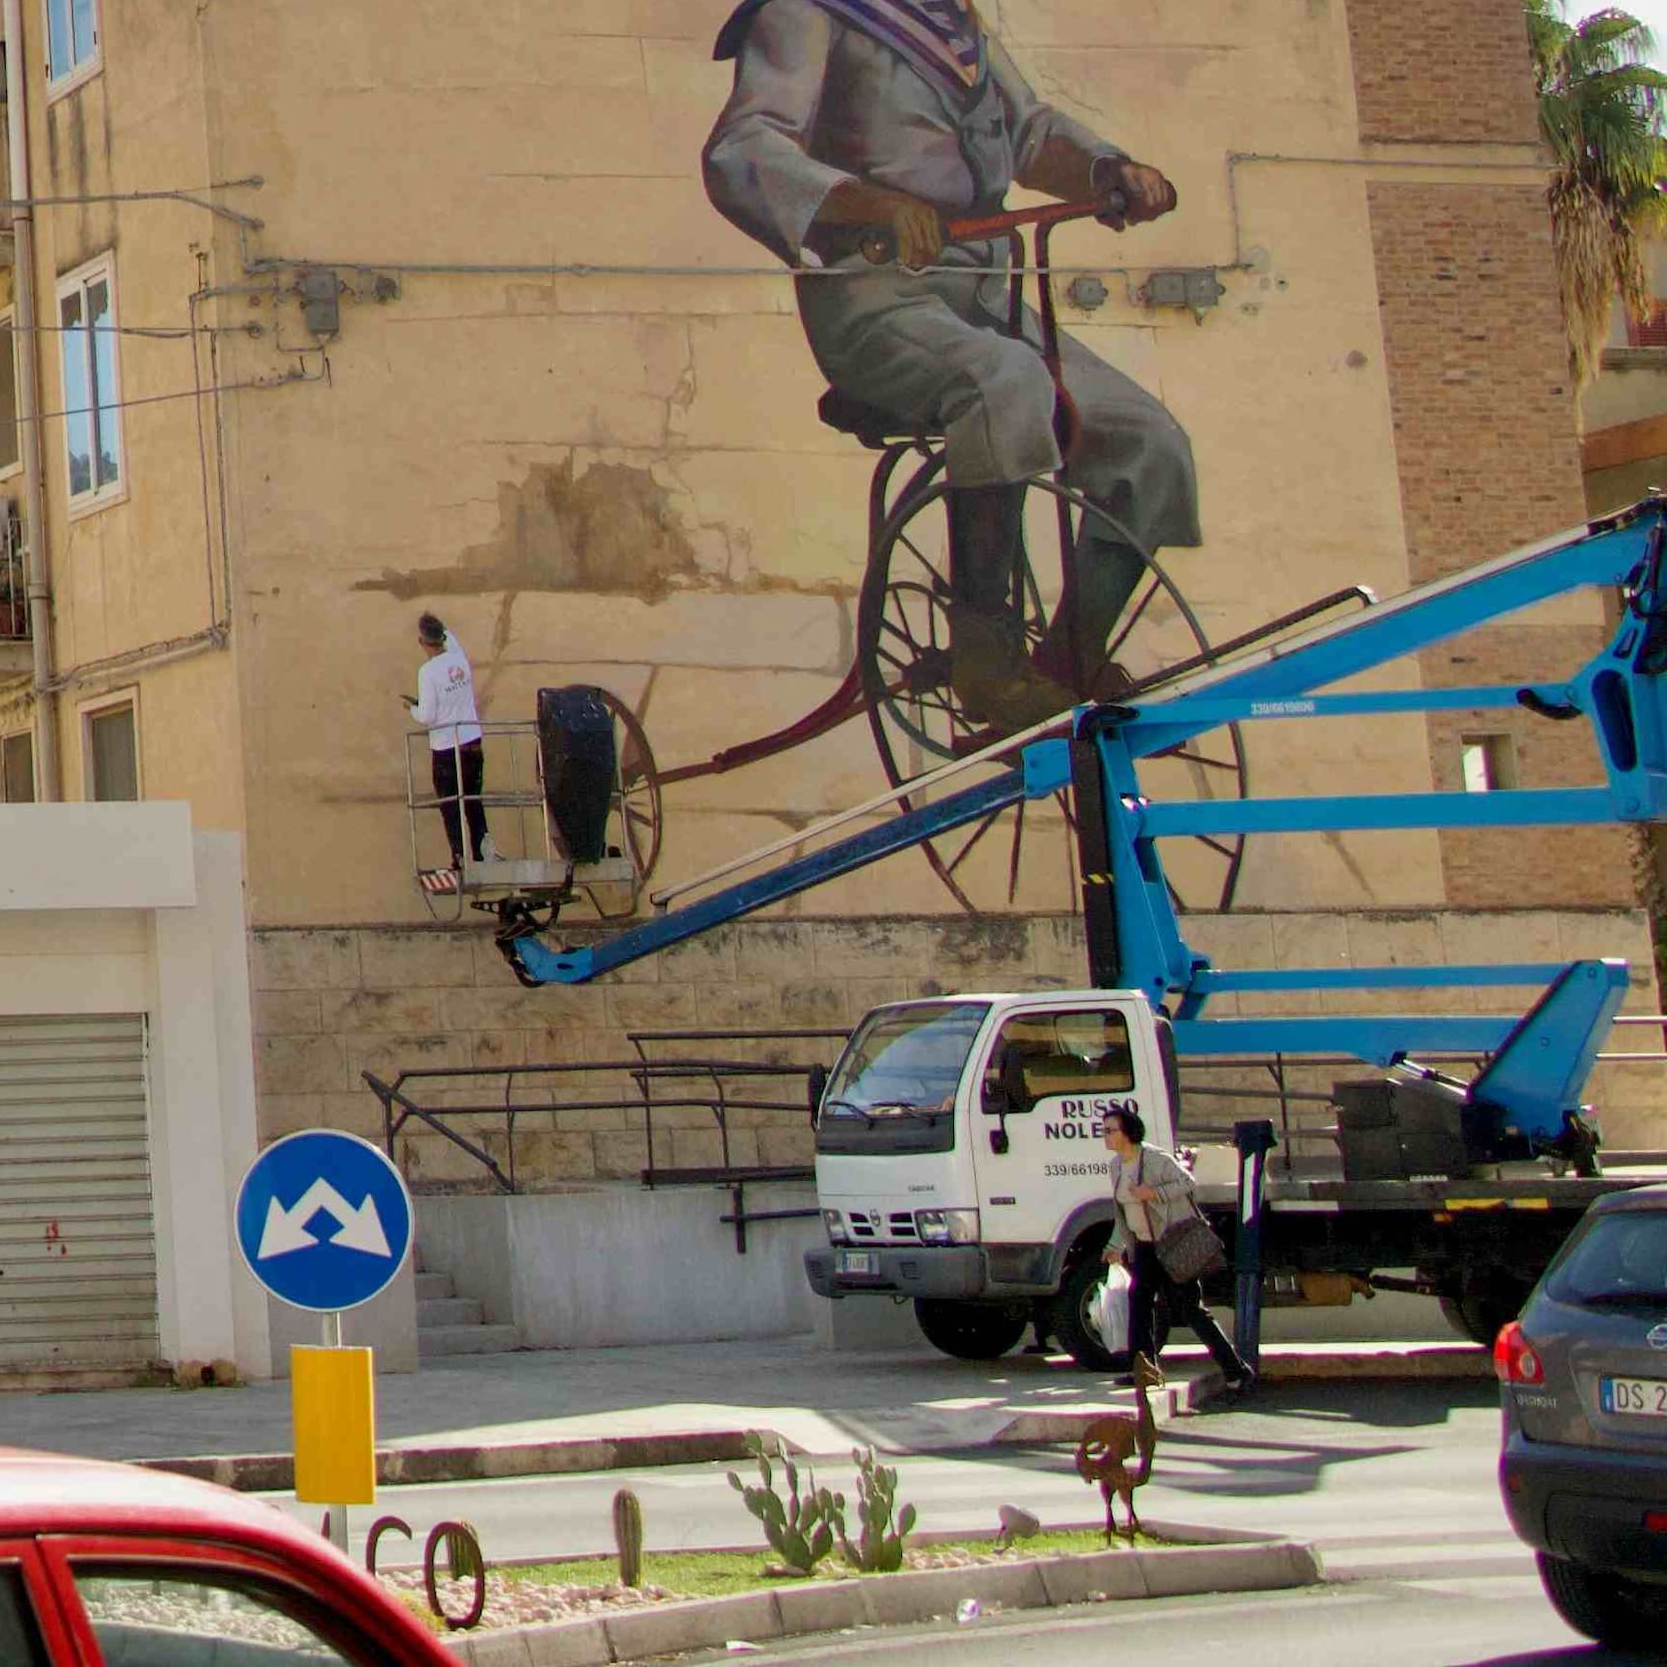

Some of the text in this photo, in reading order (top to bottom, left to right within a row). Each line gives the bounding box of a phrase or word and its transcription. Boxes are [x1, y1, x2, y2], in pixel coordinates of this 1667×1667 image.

[1061, 1098, 1139, 1119] RUSSO
[1044, 1122, 1105, 1140] NOLE
[1044, 1162, 1112, 1176] 339/66198
[1617, 1382, 1644, 1410] DS
